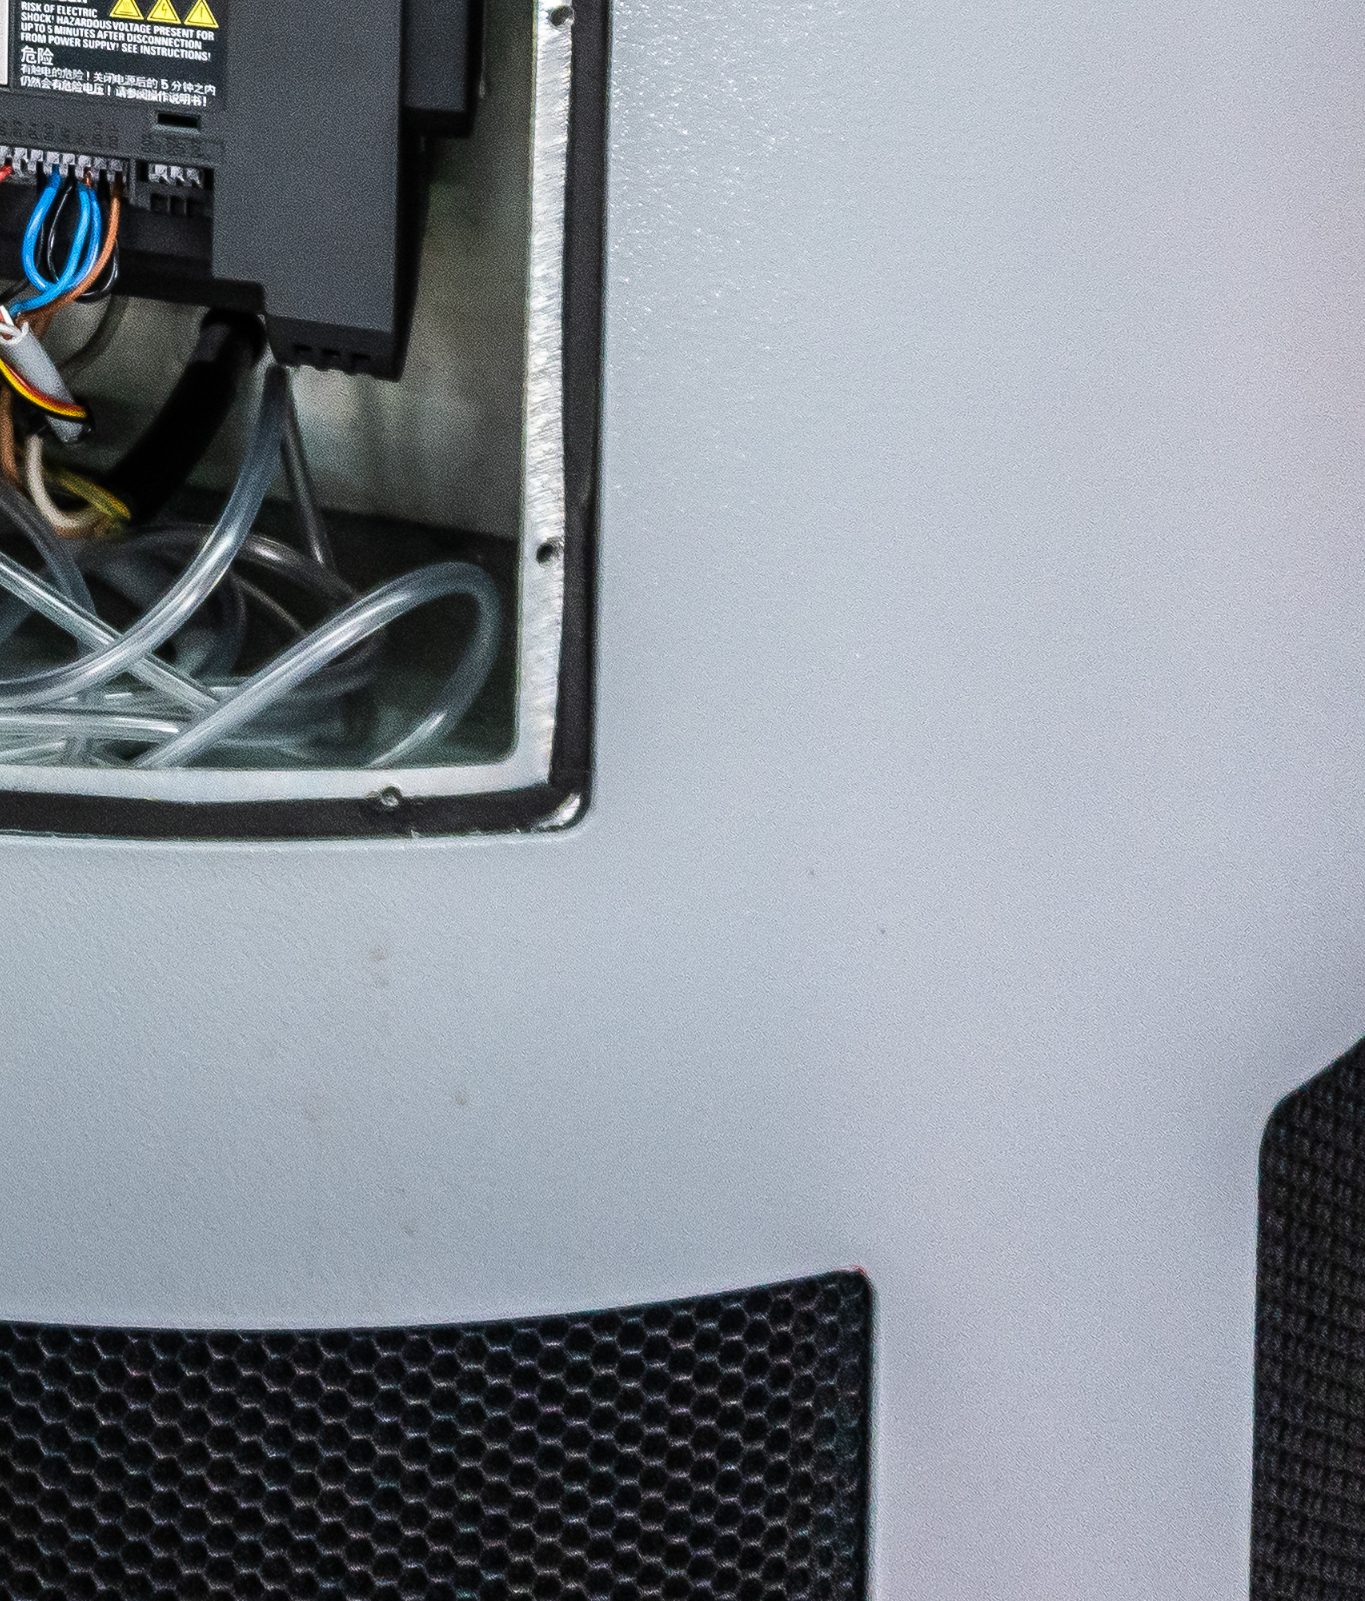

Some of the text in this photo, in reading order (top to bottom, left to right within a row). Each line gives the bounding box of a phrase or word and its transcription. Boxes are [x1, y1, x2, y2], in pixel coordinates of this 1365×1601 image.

[21, 1, 98, 19] RISK OF ELECTRIC
[21, 11, 215, 42] SHOCK! HAZARDOUS VOLTAGE PRESENT FOR
[47, 24, 54, 34] 5
[54, 24, 96, 40] MINUTES
[97, 29, 126, 42] AFTER
[126, 30, 203, 50] DISCONNECTION
[20, 44, 55, 67] 危险
[21, 31, 212, 62] FROM POWER SUPPLY! SEE INSTRUCTIONS!
